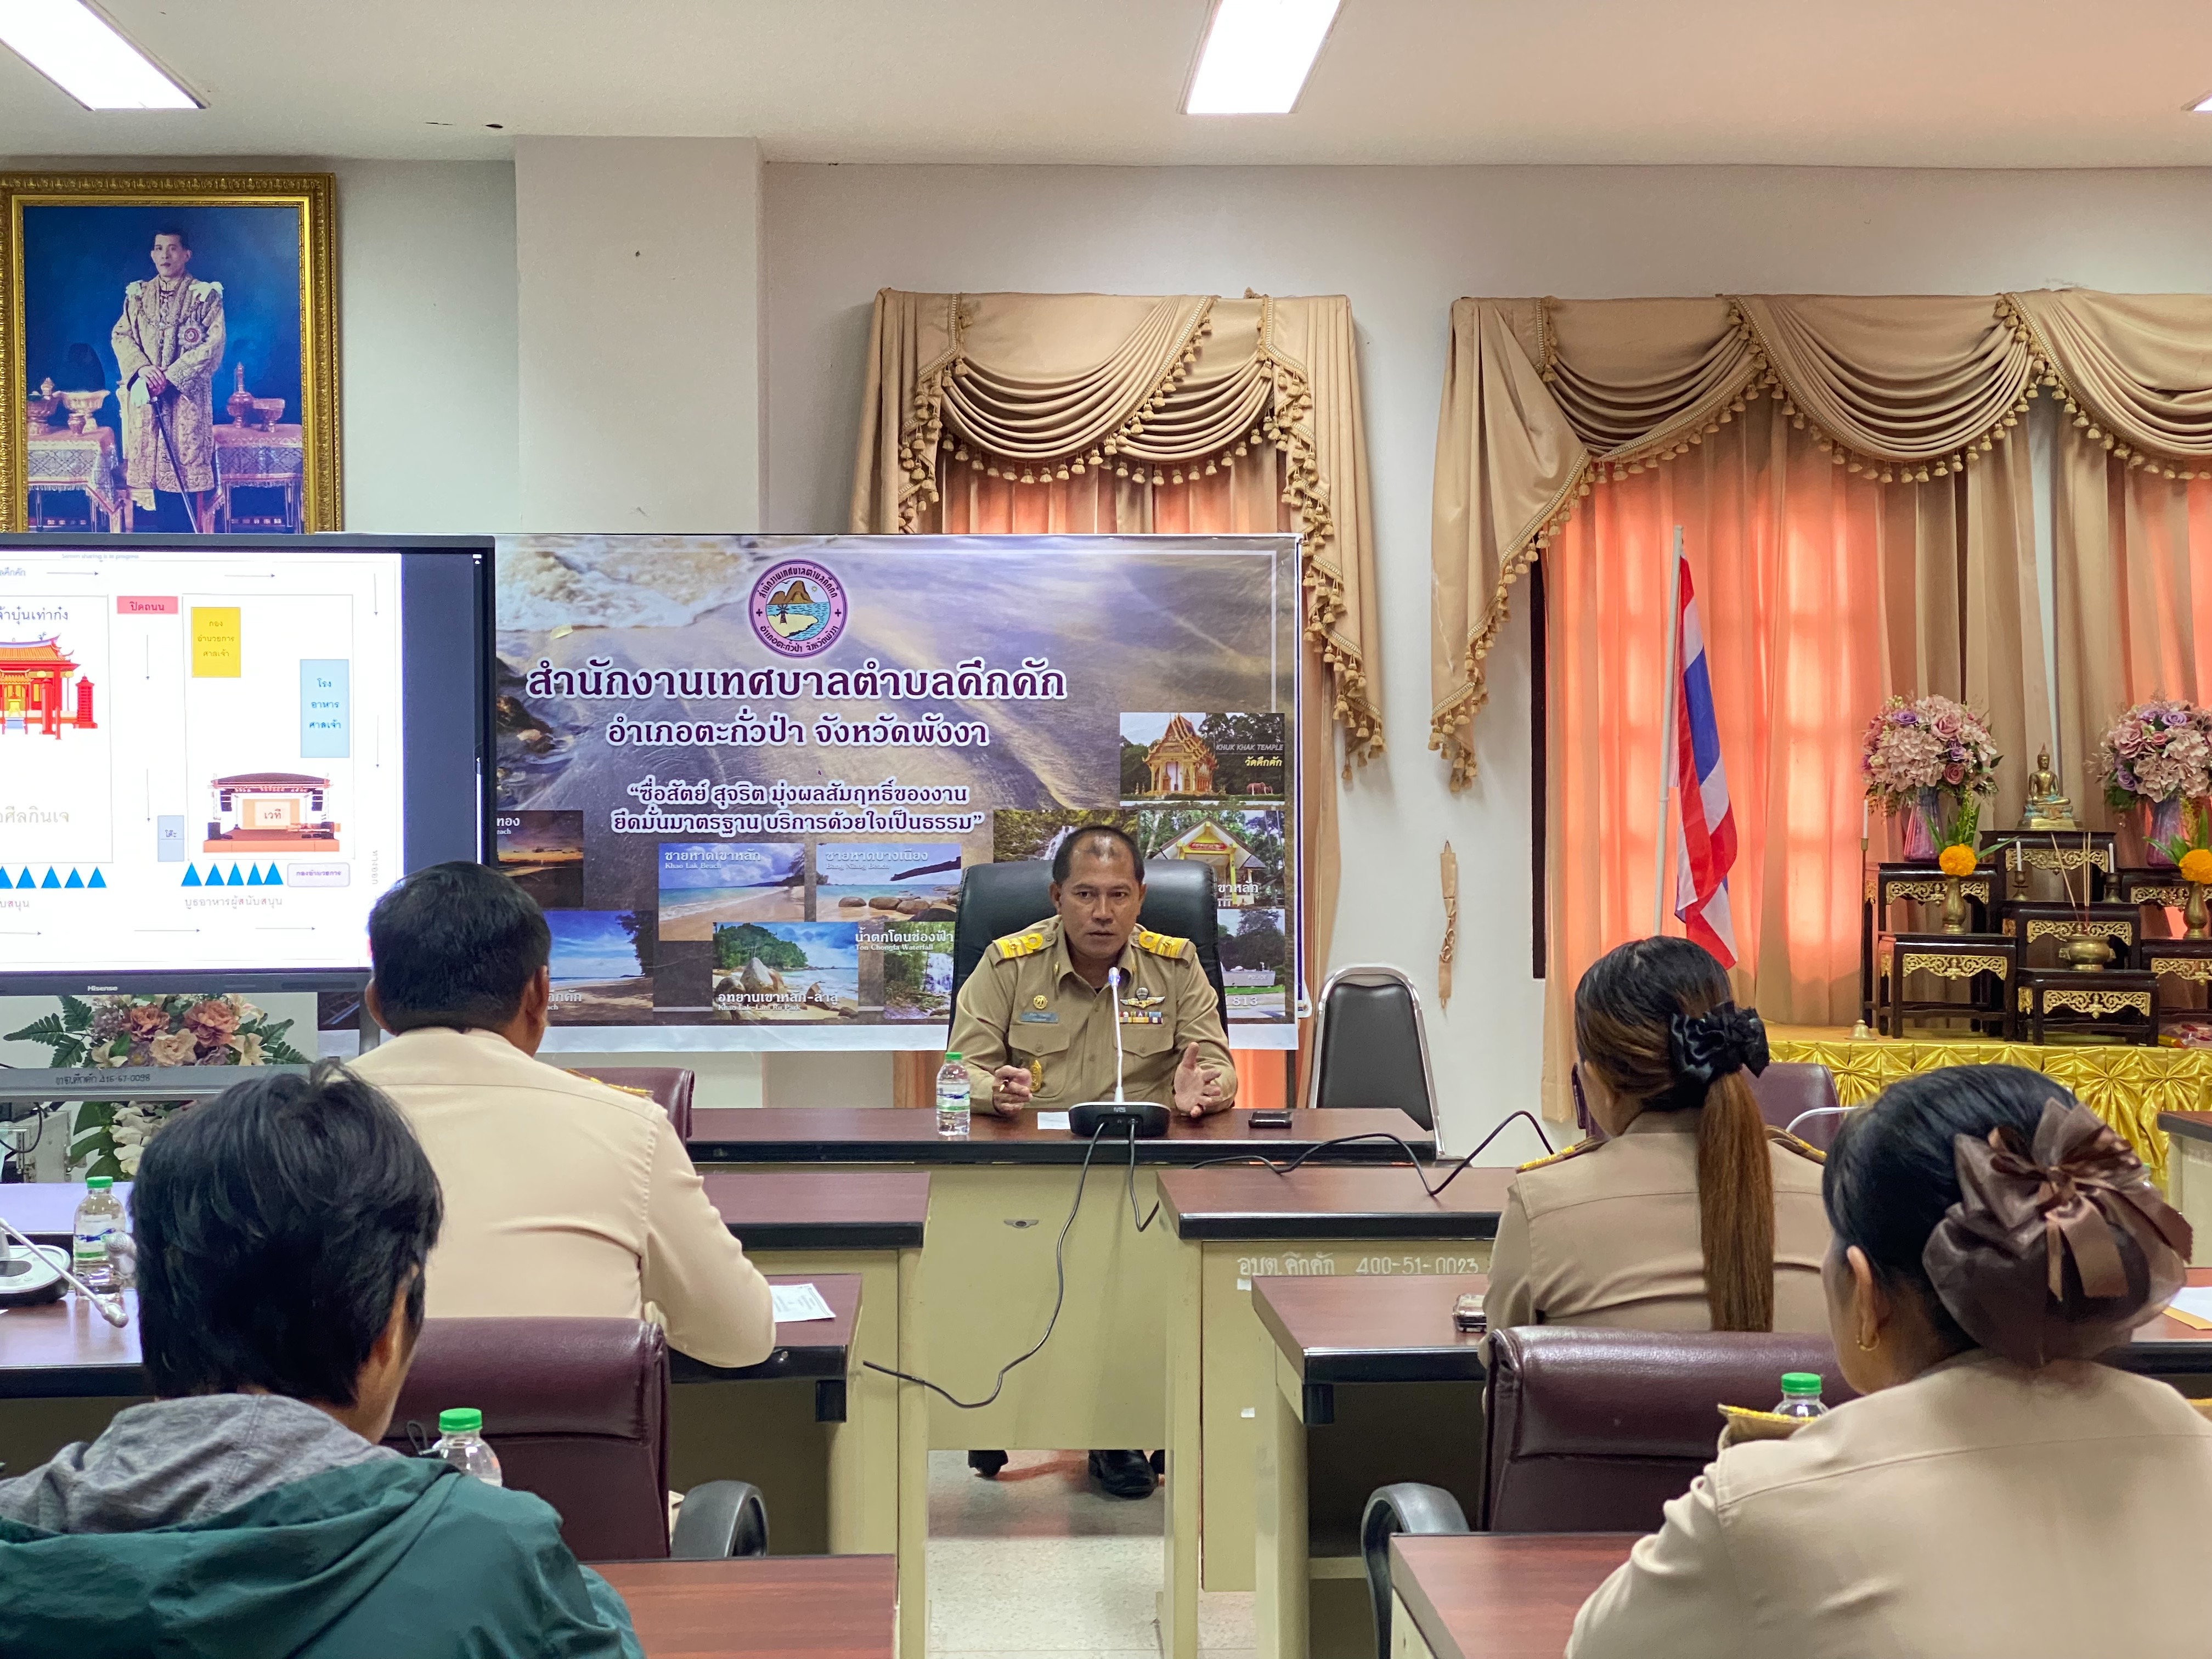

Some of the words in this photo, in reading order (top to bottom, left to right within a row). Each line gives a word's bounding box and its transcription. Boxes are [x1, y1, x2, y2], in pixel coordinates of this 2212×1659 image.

[129, 601, 165, 611] ปิดถนน
[197, 634, 235, 642] อำนวยการ
[528, 659, 1065, 697] สำนักงานเทศบาลตำบลคึกคัก
[608, 707, 804, 744] อำเภอตะกั่วป่า
[816, 715, 988, 744] จังหวัดพังงา
[630, 778, 708, 802] “ซื่อสัตย์
[714, 785, 765, 806] สุจริต
[772, 778, 967, 806] มุ่งผลสัมฤทธิ์ของงาน
[263, 808, 282, 820] เวที
[614, 806, 759, 834] ยึดมั่นมาตรฐาน
[765, 809, 982, 830] บริการด้วยใจเป็นธรรม”
[664, 848, 761, 861] ชายหาดเขาหลัก
[826, 848, 928, 861] ชายหาดบางเนียง
[855, 927, 955, 943] น้ำตกโตนช่องฟ้า
[1232, 996, 1258, 1006] 813
